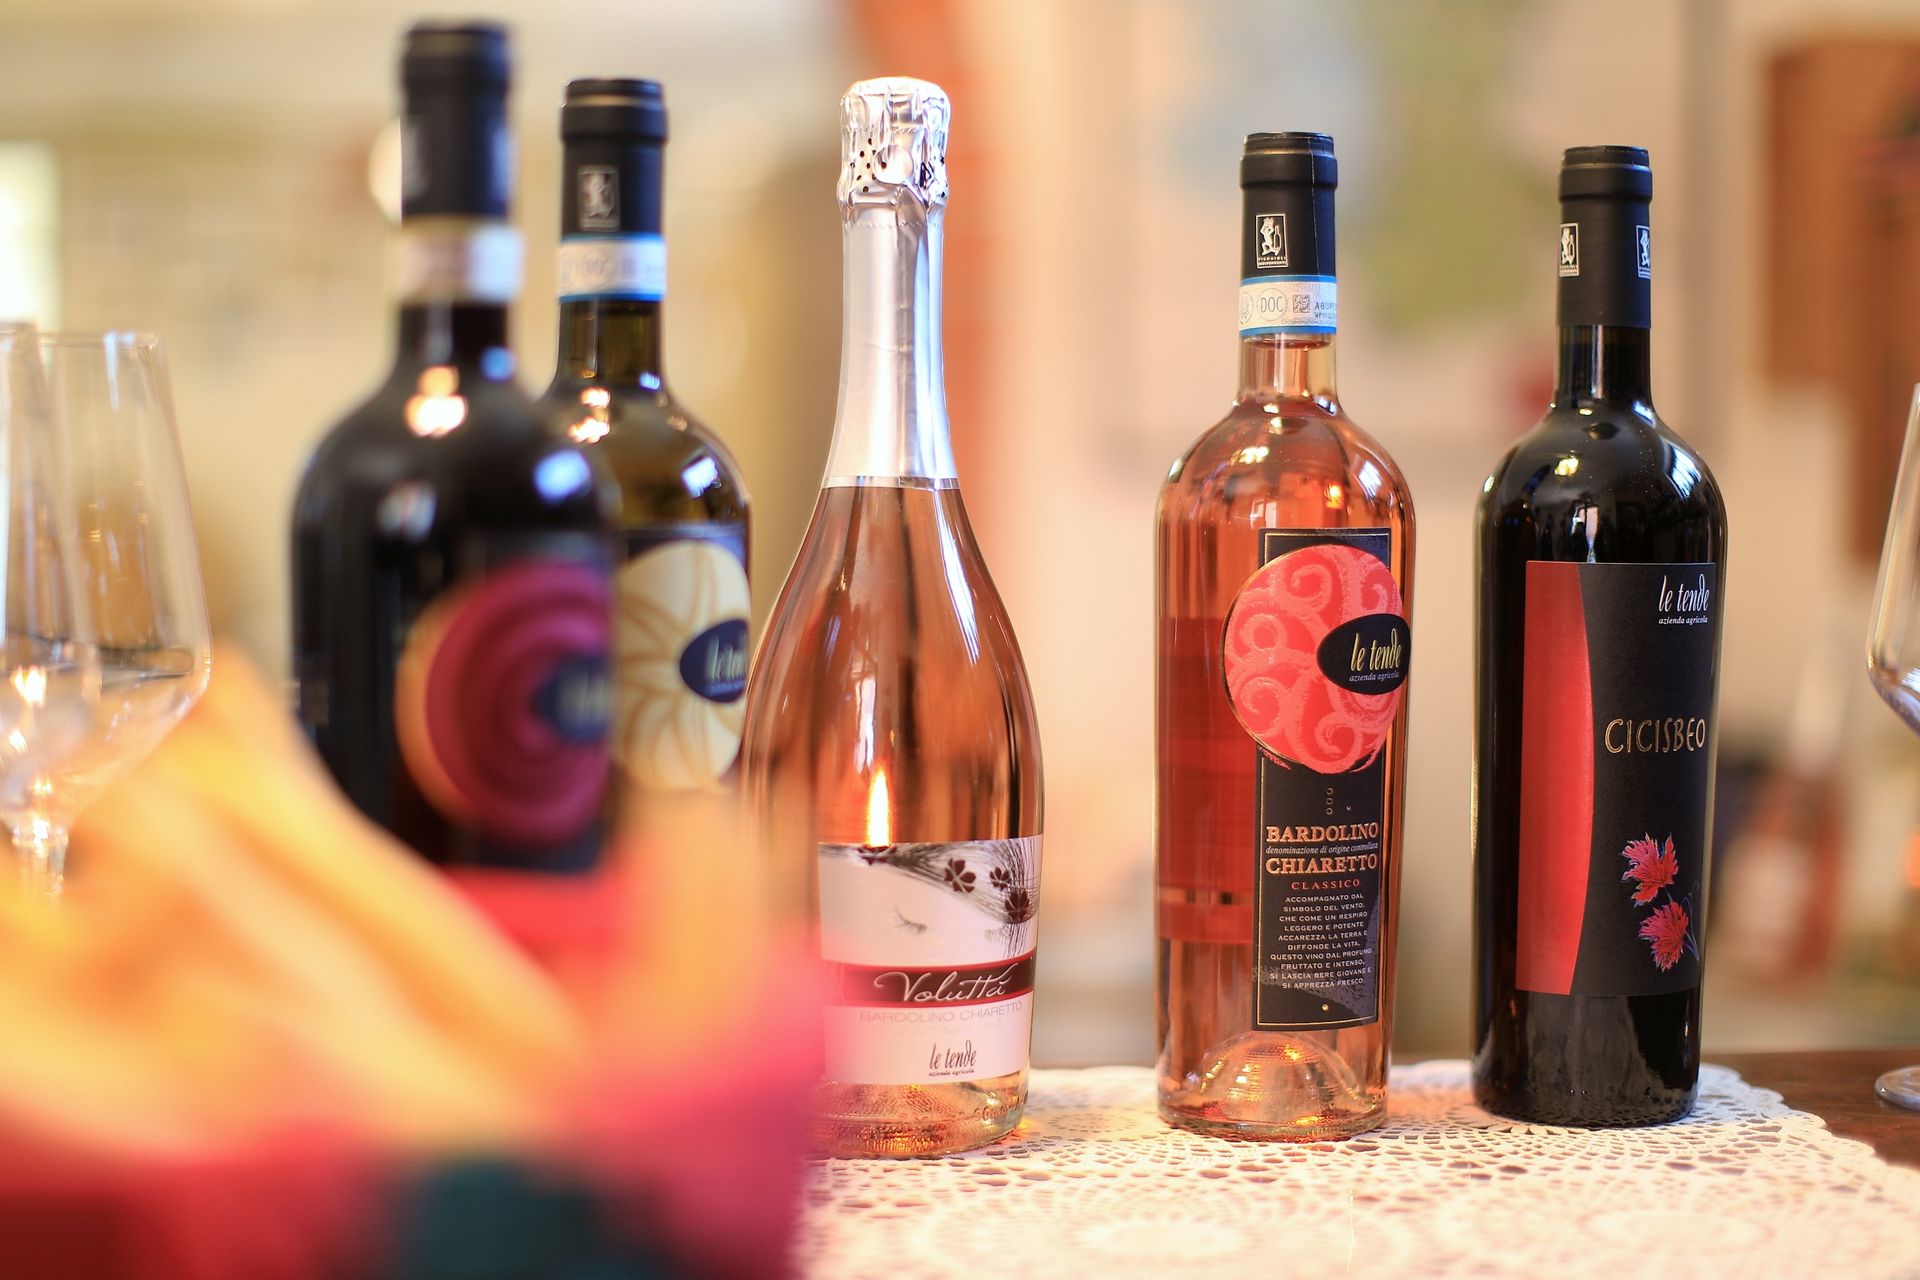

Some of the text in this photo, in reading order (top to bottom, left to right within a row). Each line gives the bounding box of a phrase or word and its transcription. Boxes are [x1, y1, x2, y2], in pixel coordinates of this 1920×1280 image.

[1260, 296, 1283, 313] DOC
[1658, 573, 1710, 612] le tende
[1658, 615, 1708, 625] azienda agricola
[1350, 628, 1402, 671] le tende
[1349, 670, 1399, 682] azienda agricola
[1604, 717, 1706, 754] CICISBEO
[1266, 822, 1379, 843] BARDOLINO
[1265, 842, 1378, 855] denominazione di origine controllata
[1265, 853, 1378, 874] CHIARETTO
[1291, 879, 1360, 890] CLASSICO
[1285, 894, 1349, 903] ACCOMPAGNATO
[1339, 911, 1368, 920] RESPIRO
[1284, 924, 1323, 932] LEGGERO
[1333, 921, 1364, 930] POTENTE
[1340, 931, 1362, 939] TERRA
[1287, 943, 1329, 951] DIFFONDE
[1342, 948, 1372, 958] PROFUMO
[1281, 962, 1323, 970] FRUTTATO
[1336, 968, 1366, 977] GIOVANE
[1336, 978, 1363, 987] FRESCO
[860, 1001, 1023, 1023] BARDOLINO CHIARETTO
[930, 1039, 977, 1069] le tende
[952, 1068, 974, 1076] agricola
